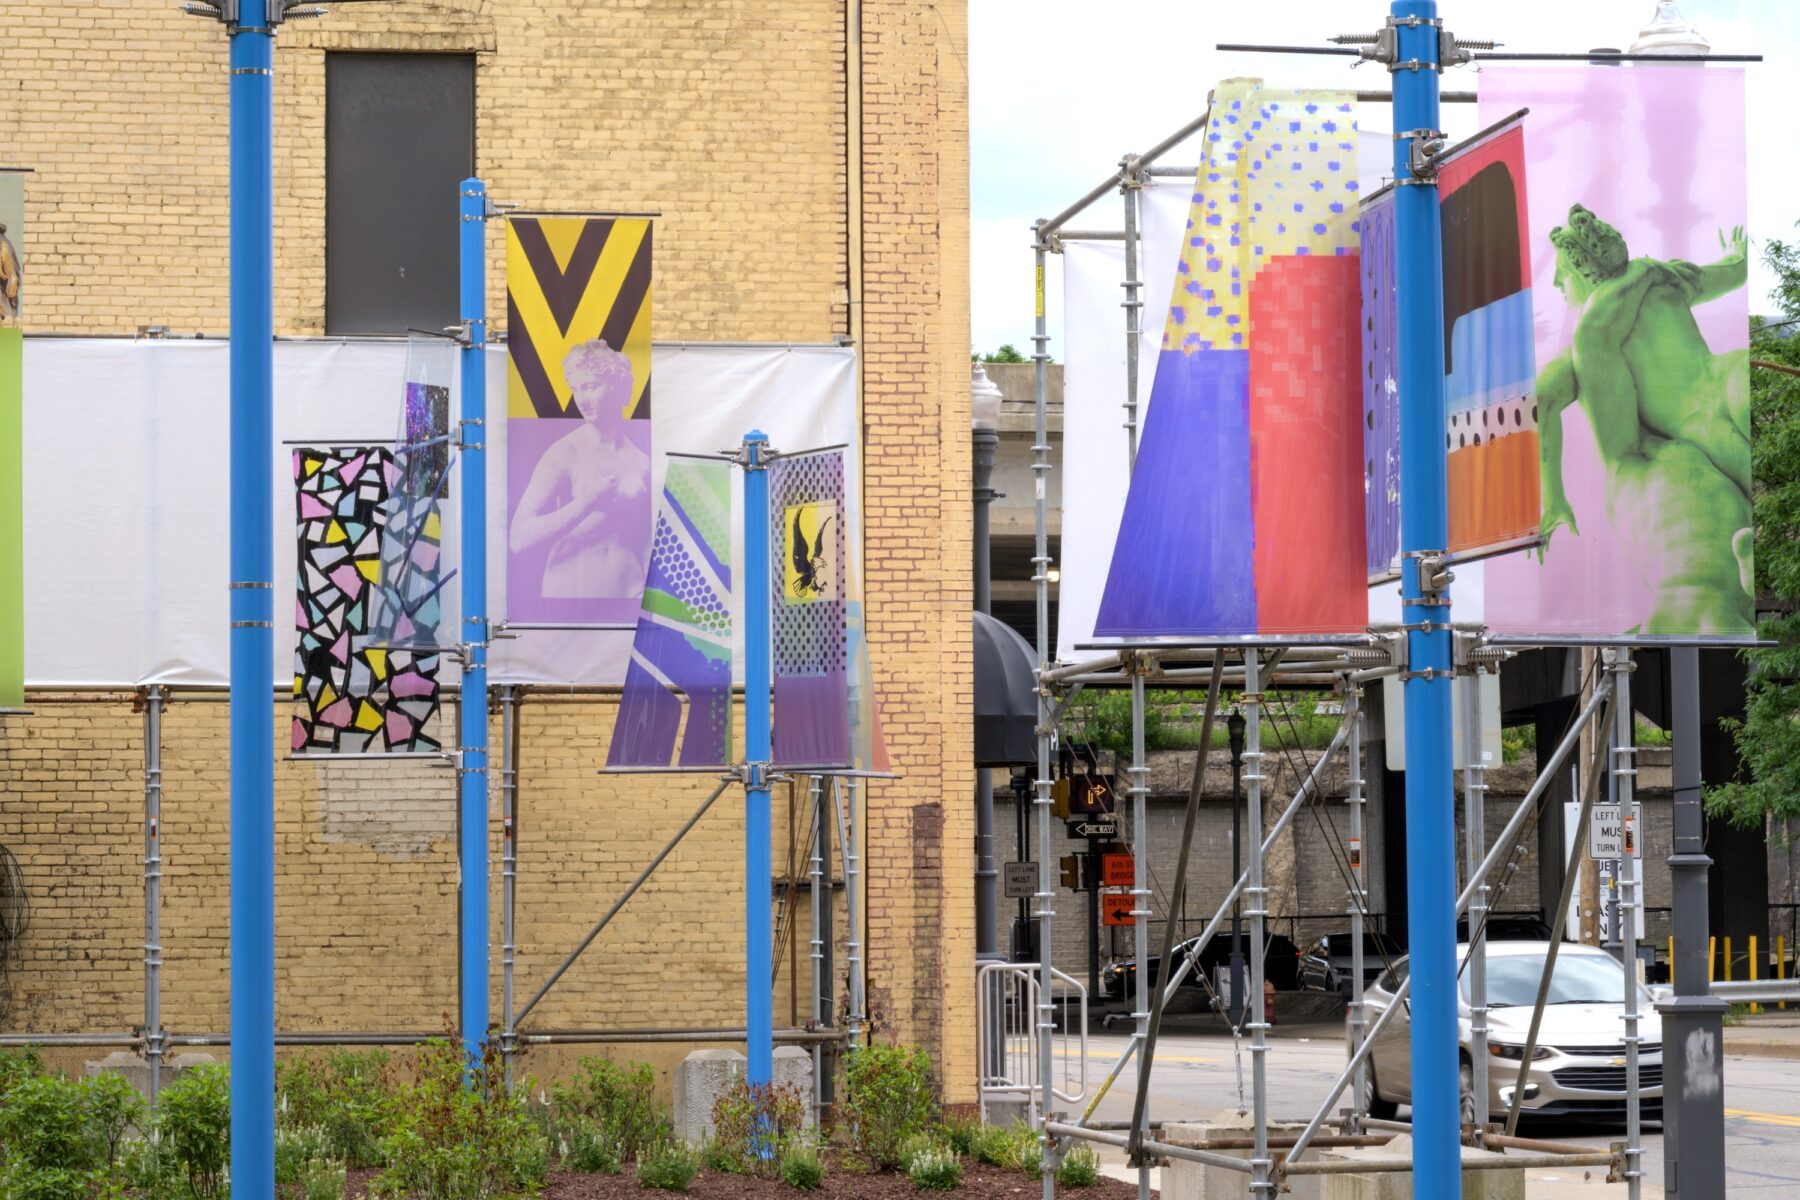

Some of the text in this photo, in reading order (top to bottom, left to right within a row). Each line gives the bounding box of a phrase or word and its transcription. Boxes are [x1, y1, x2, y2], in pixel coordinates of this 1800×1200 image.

[1595, 811, 1637, 821] LEFT LE
[1601, 827, 1622, 838] MUS
[1596, 843, 1615, 852] TURN
